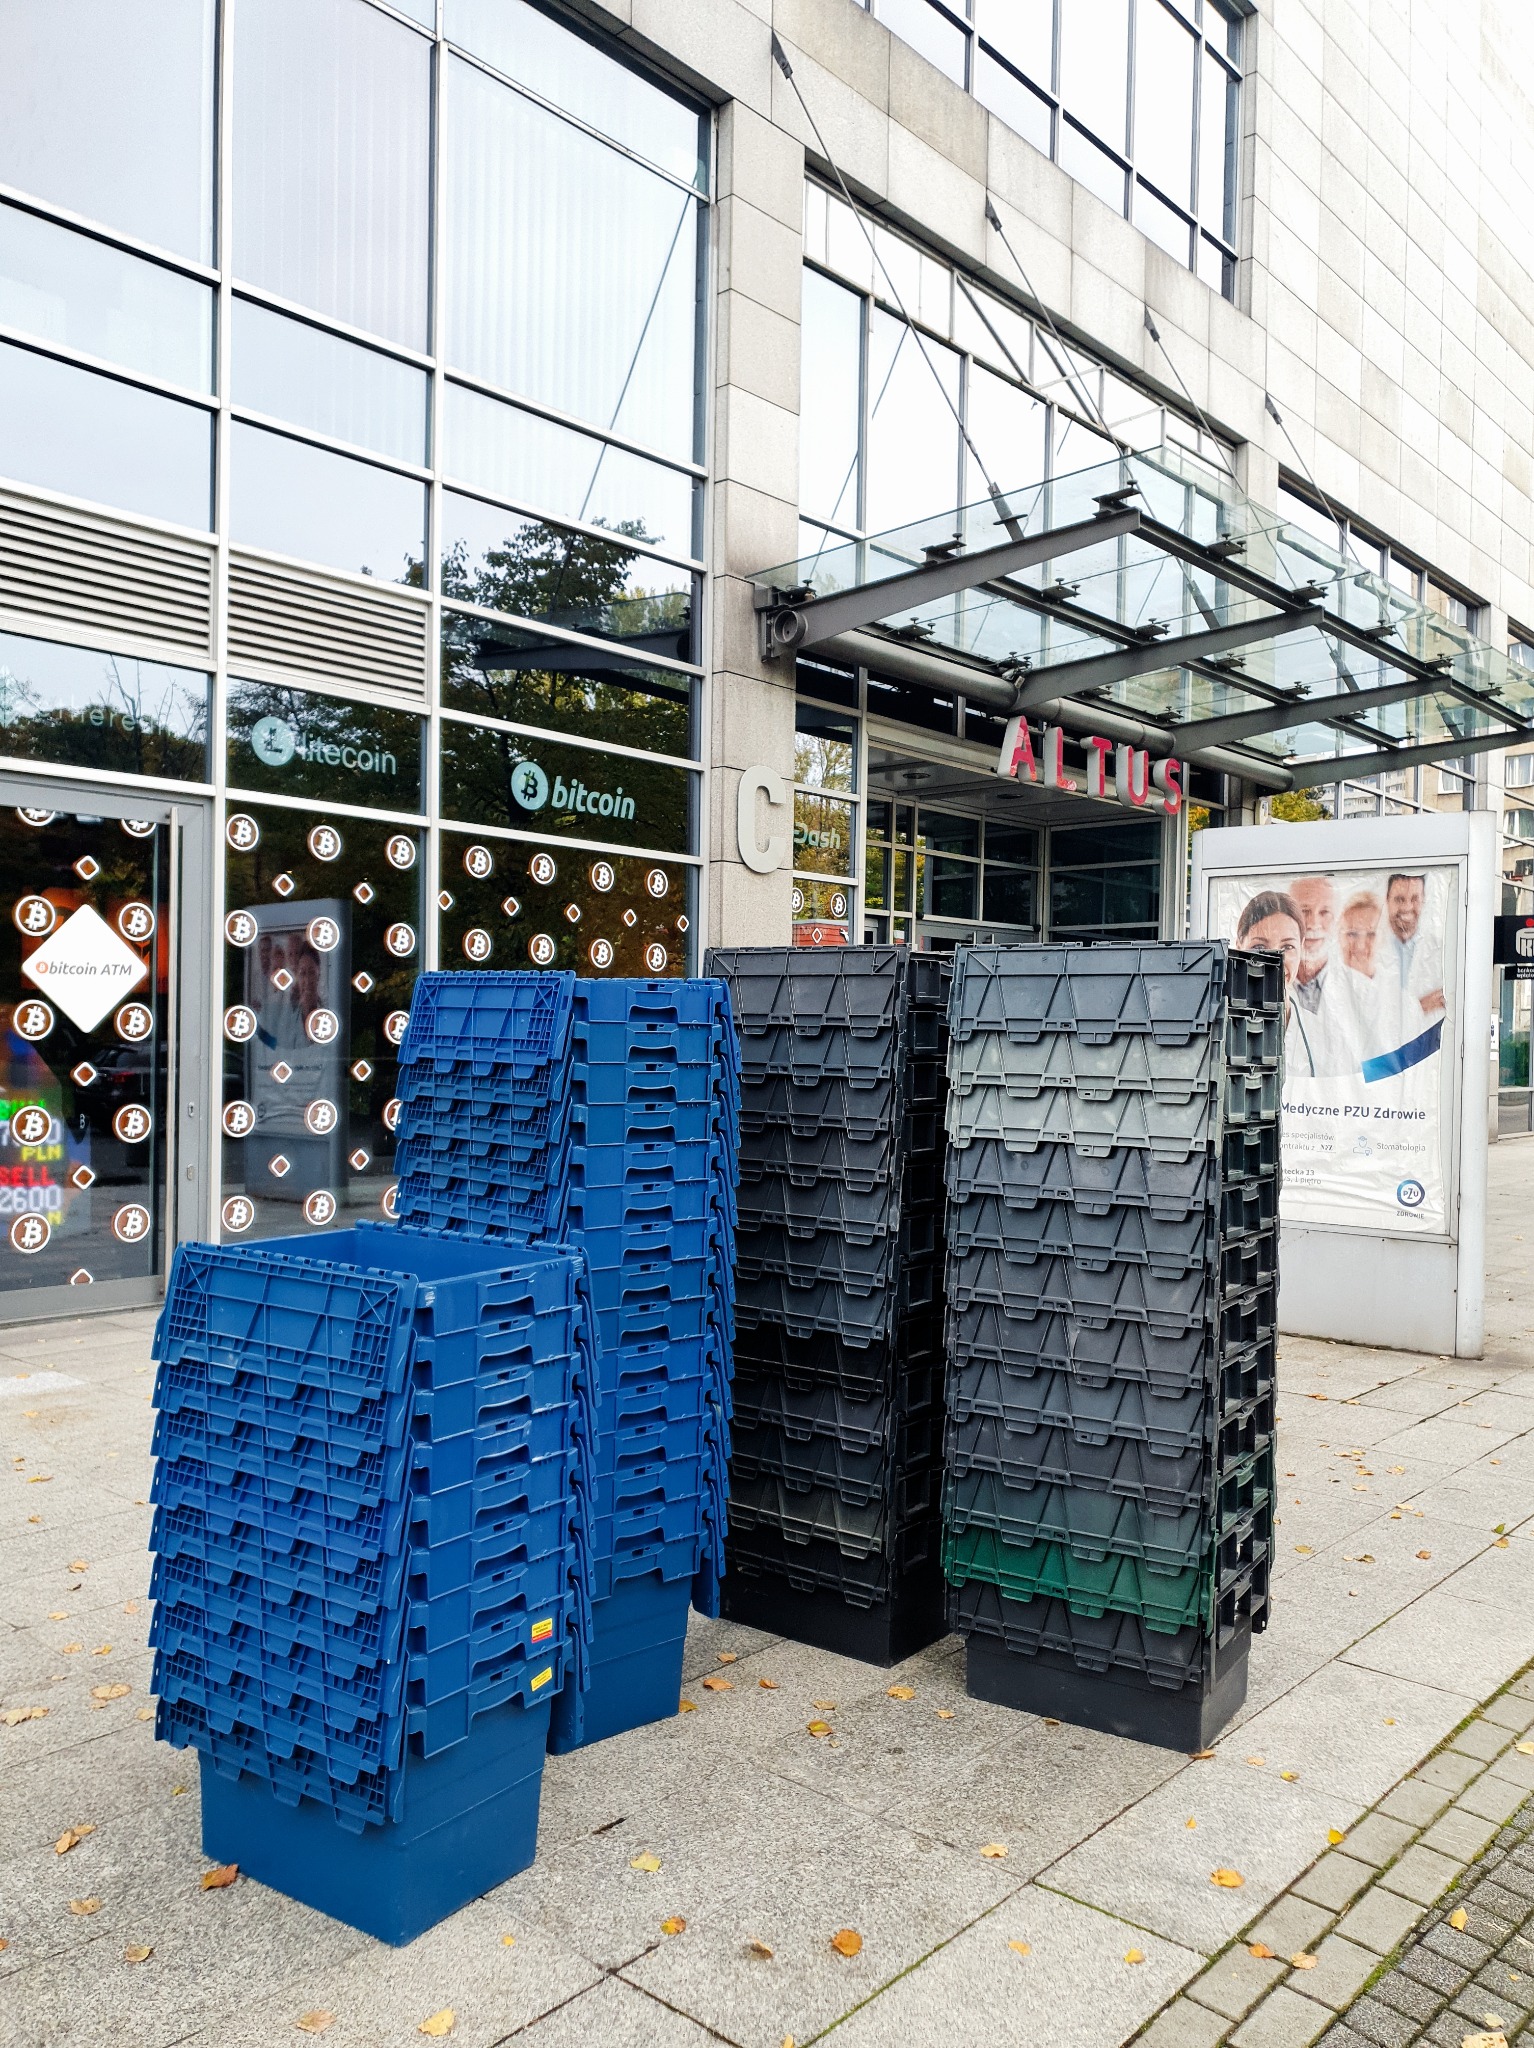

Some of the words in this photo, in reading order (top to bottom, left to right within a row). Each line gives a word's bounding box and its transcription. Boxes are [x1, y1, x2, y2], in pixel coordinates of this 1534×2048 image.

[300, 730, 397, 775] litecoin
[997, 714, 1182, 815] ALTUS
[551, 775, 636, 820] bitcoin
[737, 764, 787, 874] C
[793, 821, 841, 850] Dash
[49, 961, 97, 976] bitcoin
[100, 963, 132, 976] ATM
[1282, 1102, 1340, 1117] Medyczne
[1344, 1105, 1370, 1118] PZU
[1374, 1107, 1426, 1120] Zdrowie
[1291, 1131, 1335, 1141] specjalistów
[21, 1145, 62, 1161] PLN
[1376, 1142, 1426, 1153] Stomatologia
[1403, 1187, 1419, 1200] PZU
[1396, 1210, 1425, 1220] ZDROWIE
